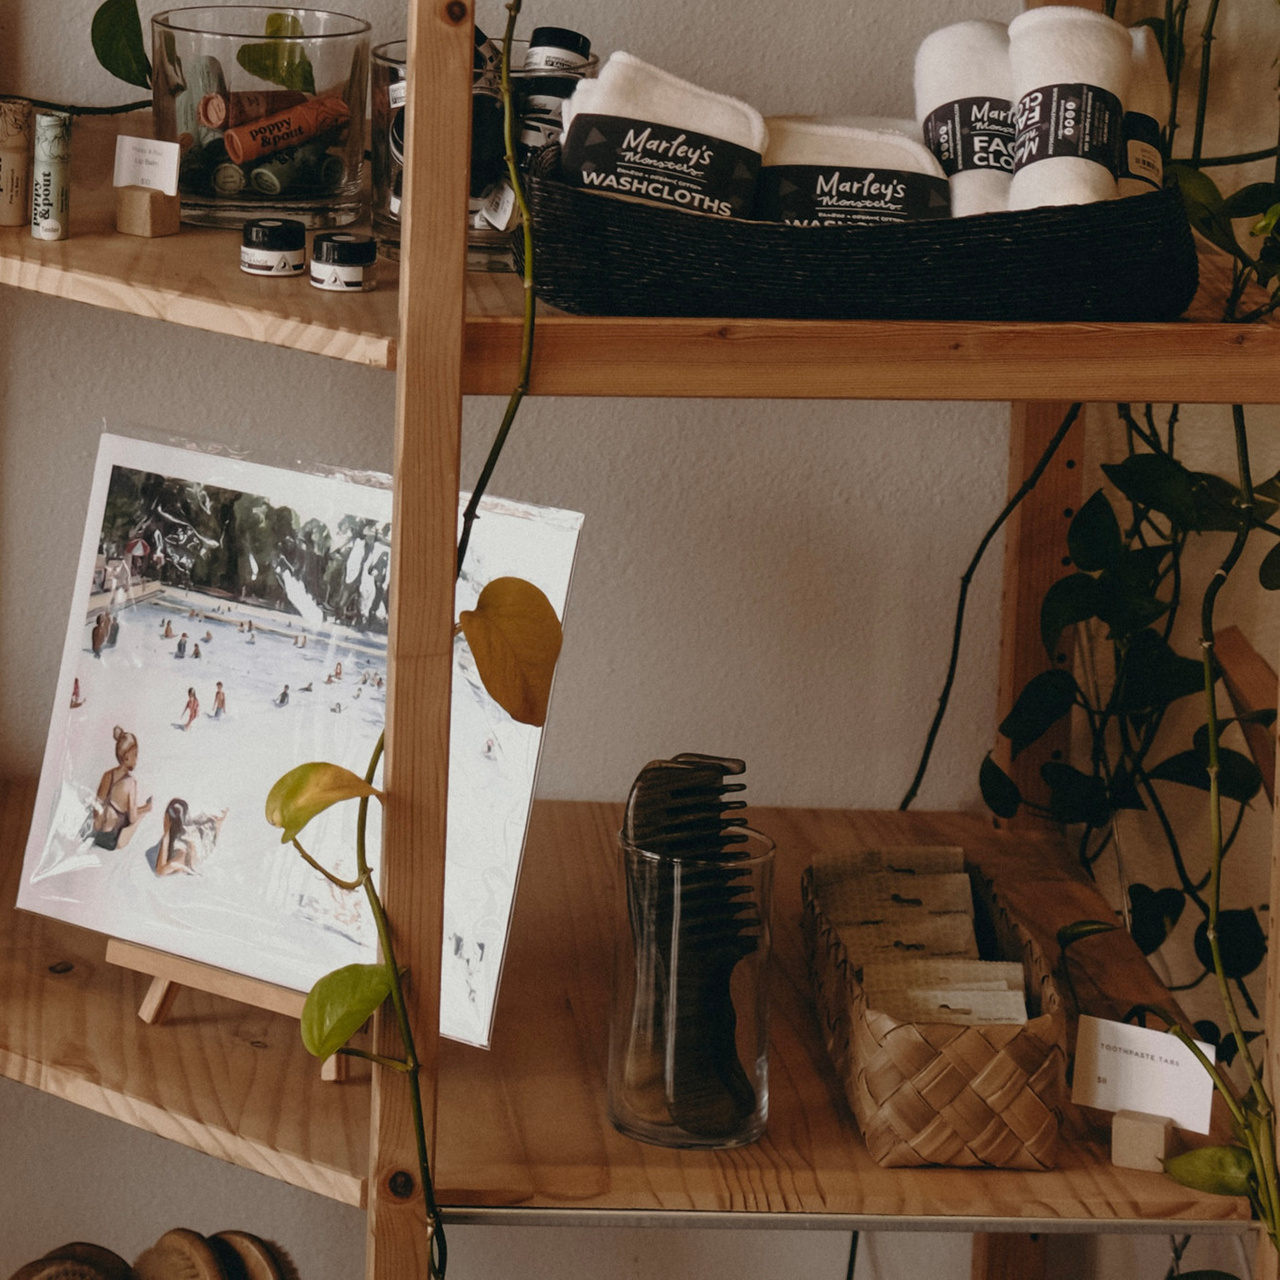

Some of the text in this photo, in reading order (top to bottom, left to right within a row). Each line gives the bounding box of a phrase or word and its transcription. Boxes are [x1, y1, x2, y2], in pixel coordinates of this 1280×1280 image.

[249, 117, 292, 141] poppy
[622, 128, 714, 166] Marley's
[621, 151, 705, 176] Monsters
[582, 170, 732, 217] WASHCLOTHS
[816, 171, 907, 202] Marley's
[817, 196, 903, 210] Monsters
[41, 226, 60, 234] Tester
[1100, 1042, 1180, 1066] TOOTHPASTE TABS
